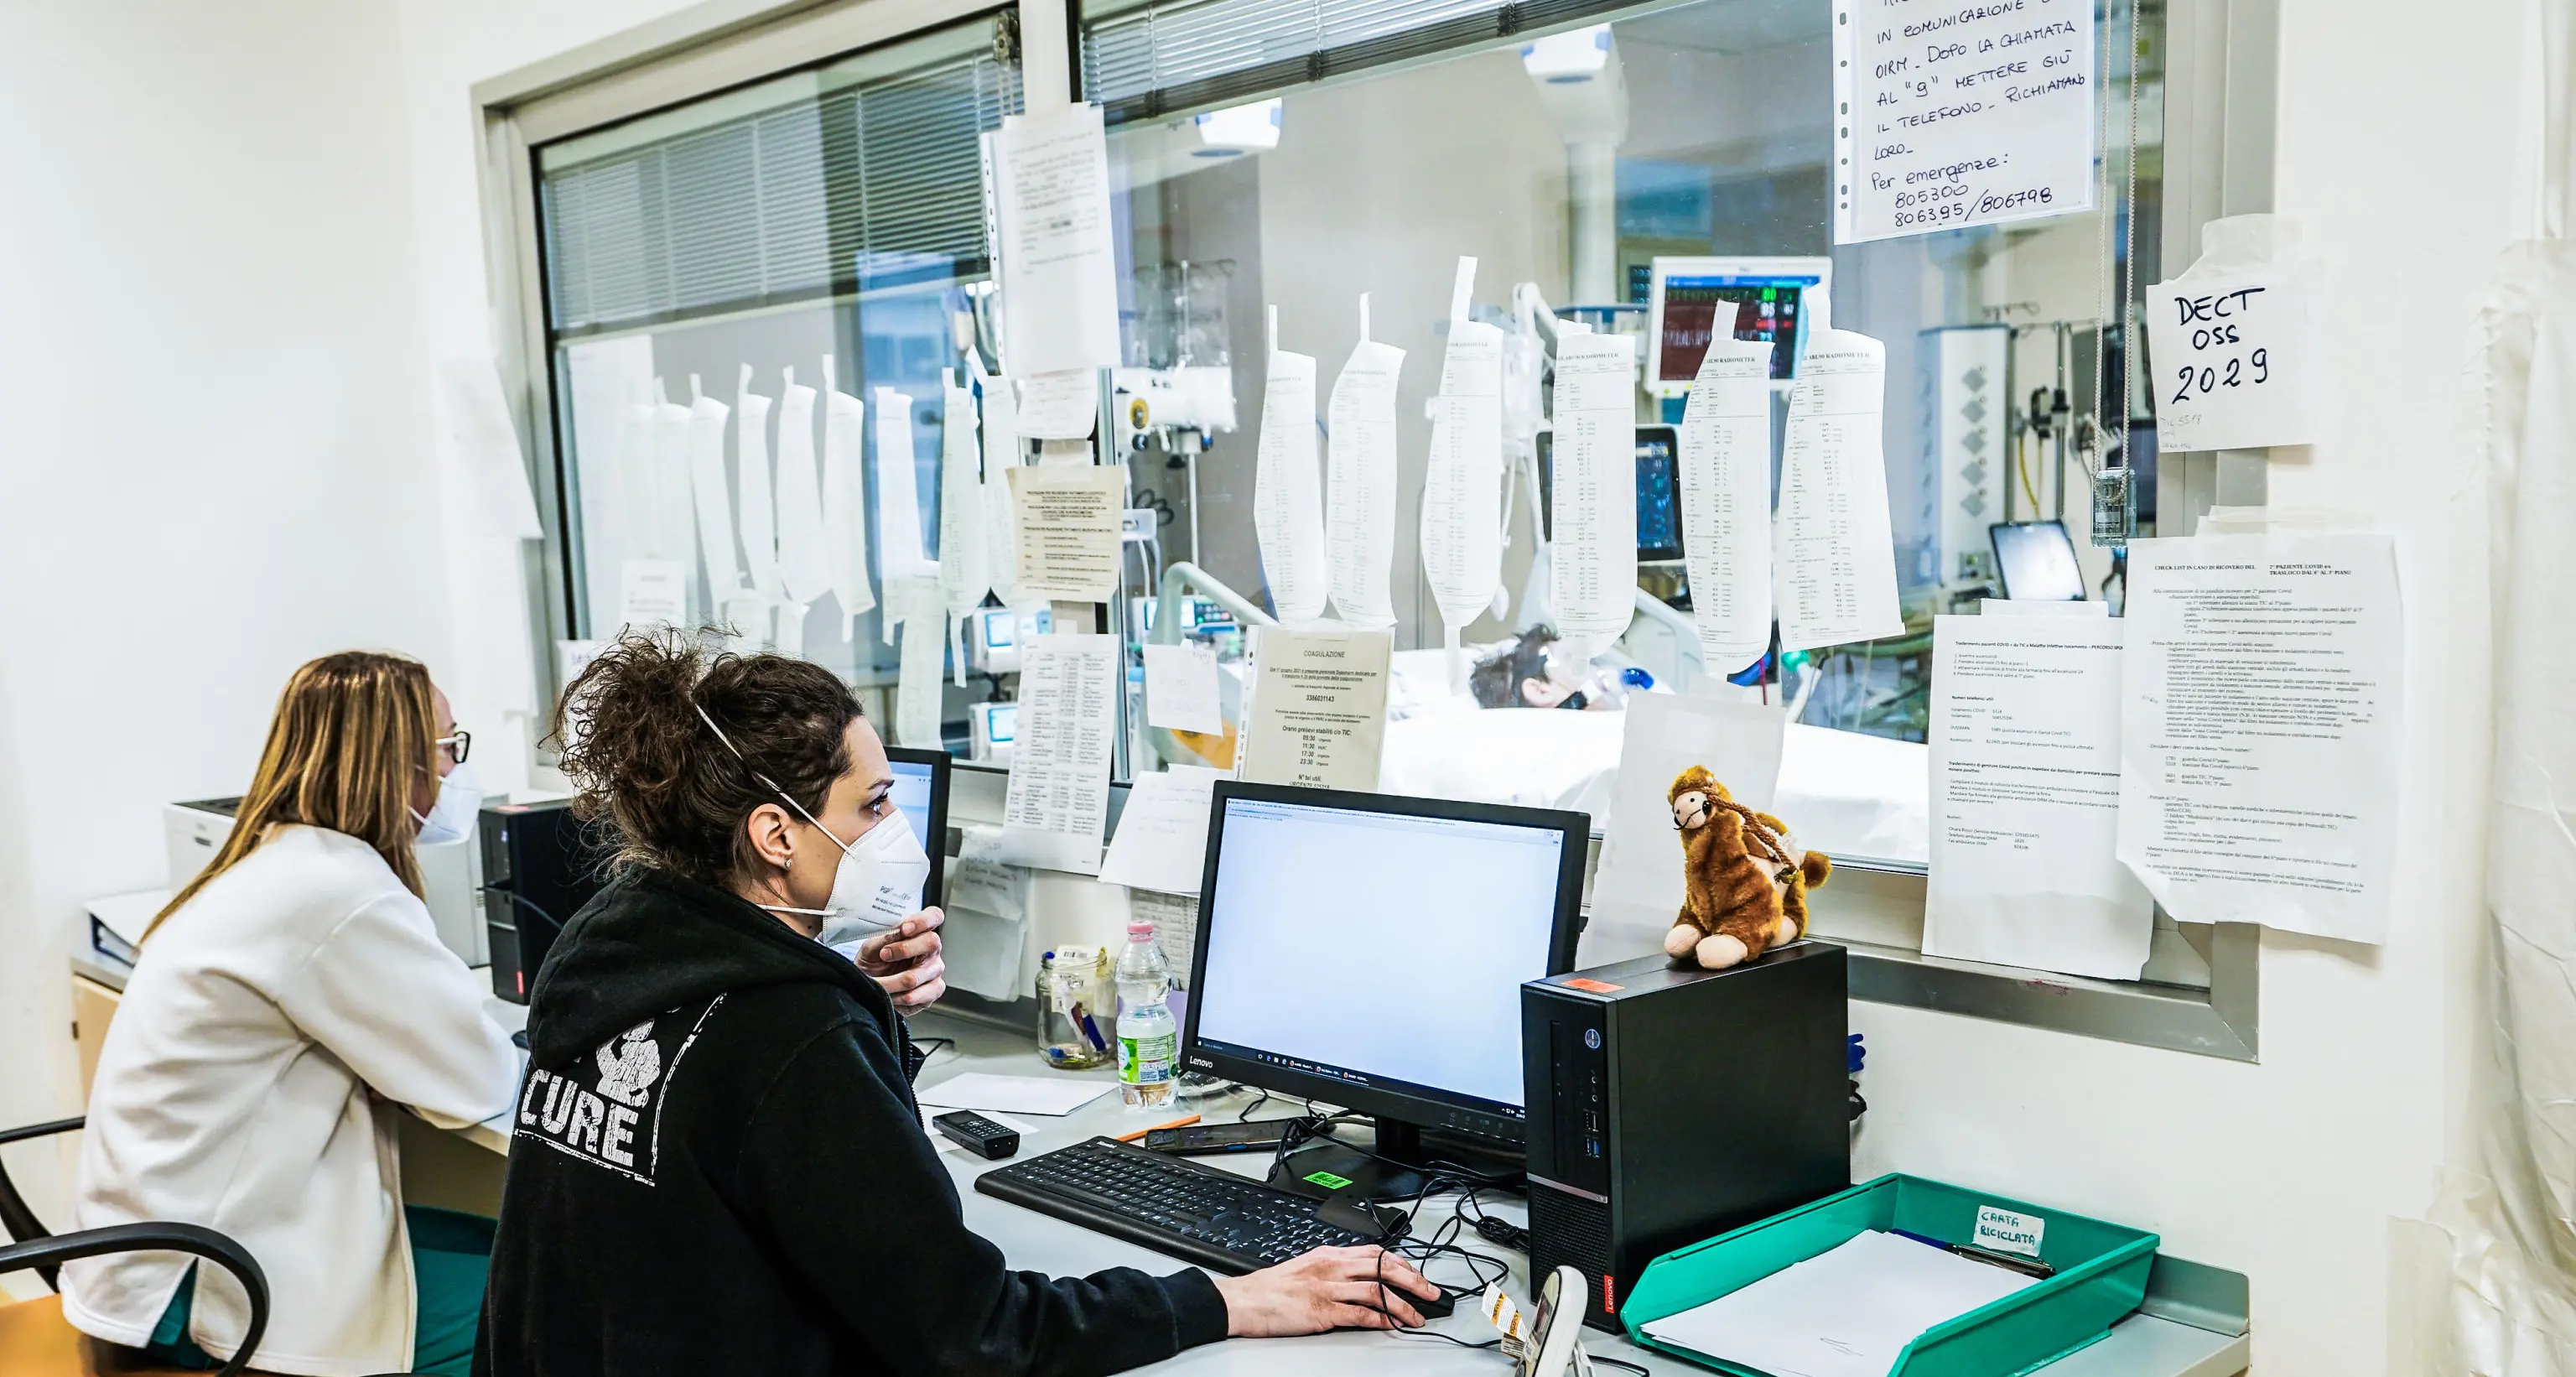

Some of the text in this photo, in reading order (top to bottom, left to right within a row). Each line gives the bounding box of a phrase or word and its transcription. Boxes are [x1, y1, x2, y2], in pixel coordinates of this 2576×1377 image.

[1877, 2, 2024, 44] IN COMUNICAZIONE
[1928, 44, 1967, 63] DOPO
[1978, 39, 1993, 53] LA
[2000, 21, 2076, 48] CHIAMATA
[1877, 92, 1898, 107] AL
[1955, 61, 2028, 89] METTERE
[1877, 73, 2085, 133] IL TELEFONO RICHIAMANO
[1872, 172, 1896, 191] Per
[1895, 184, 1968, 209] 805300
[2174, 287, 2266, 325] DECT
[2192, 325, 2241, 350] OSS
[2172, 347, 2268, 405] 2029
[1303, 650, 1346, 658] COAGULAZIONE
[1298, 726, 1316, 735] prelievi
[1316, 727, 1333, 735] stabiliti
[1343, 729, 1353, 737] TIC:
[1189, 1055, 1214, 1068] Lenovo
[520, 1068, 639, 1167] CURE
[1981, 1212, 2019, 1227] CARTA
[1980, 1225, 2035, 1246] RICICLATA
[1606, 1277, 1614, 1311] Lenovo
